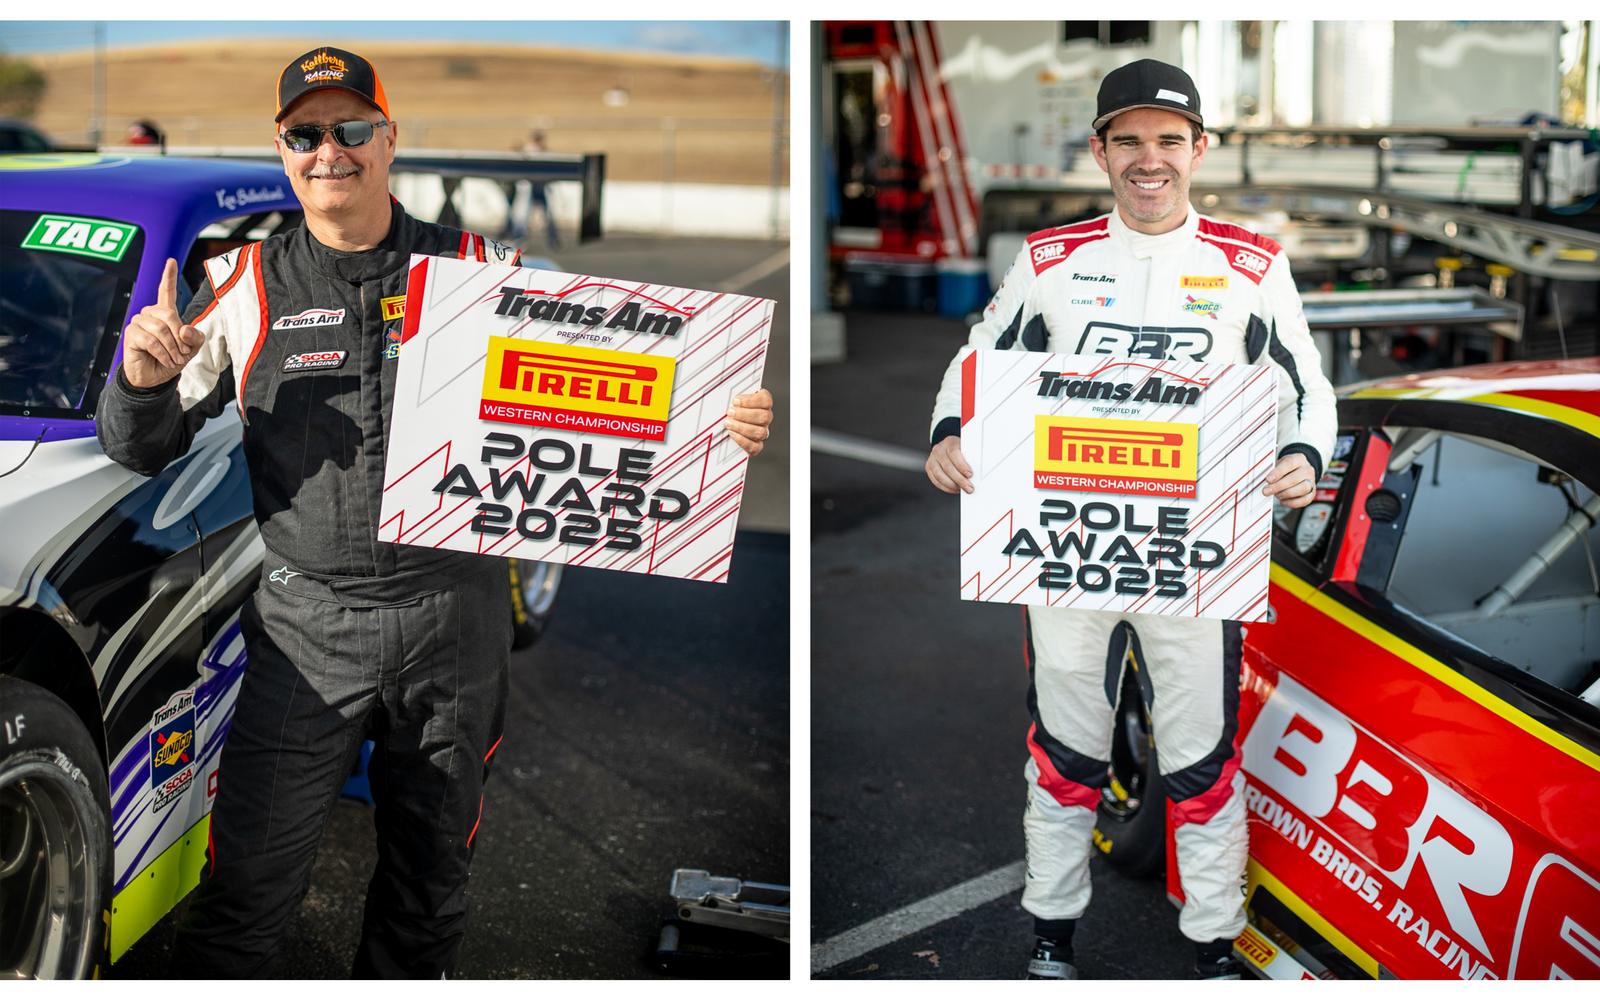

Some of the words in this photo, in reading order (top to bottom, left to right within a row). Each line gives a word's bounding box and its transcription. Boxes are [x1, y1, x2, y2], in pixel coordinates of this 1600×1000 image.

[304, 70, 344, 81] RACING
[39, 219, 124, 253] TAC
[1033, 244, 1065, 262] OMP
[1235, 253, 1267, 271] OMP
[1072, 273, 1098, 282] Trans
[1099, 275, 1116, 284] Am
[280, 317, 315, 328] Trans
[316, 314, 340, 325] Am
[495, 286, 605, 326] Trans
[604, 301, 683, 336] Am
[1184, 302, 1220, 312] SUNOCO
[557, 330, 600, 342] PRESENTED
[601, 335, 613, 343] BY
[301, 352, 341, 362] SCCA
[304, 360, 339, 368] RACING
[499, 349, 658, 407] PIRELLI
[1037, 371, 1131, 401] Trans
[1132, 377, 1200, 405] Am
[483, 404, 552, 422] WESTERN
[555, 413, 664, 435] CHAMPIONSHIP
[1092, 406, 1130, 414] PRESENTED
[481, 431, 657, 482] POLE
[1048, 425, 1184, 468] PIRELLI
[431, 463, 691, 520] AWARD
[1037, 475, 1096, 488] WESTERN
[1098, 478, 1195, 495] CHAMPIONSHIP
[470, 502, 644, 551] 2025
[1039, 498, 1190, 535] POLE
[1001, 527, 1227, 568] AWARD
[1038, 560, 1188, 597] 2025
[154, 707, 177, 725] Trans
[177, 695, 193, 712] Am
[5, 714, 25, 744] LF
[156, 732, 192, 764] SUNOCO
[165, 768, 193, 794] SCCA
[1309, 836, 1384, 911] BROS.
